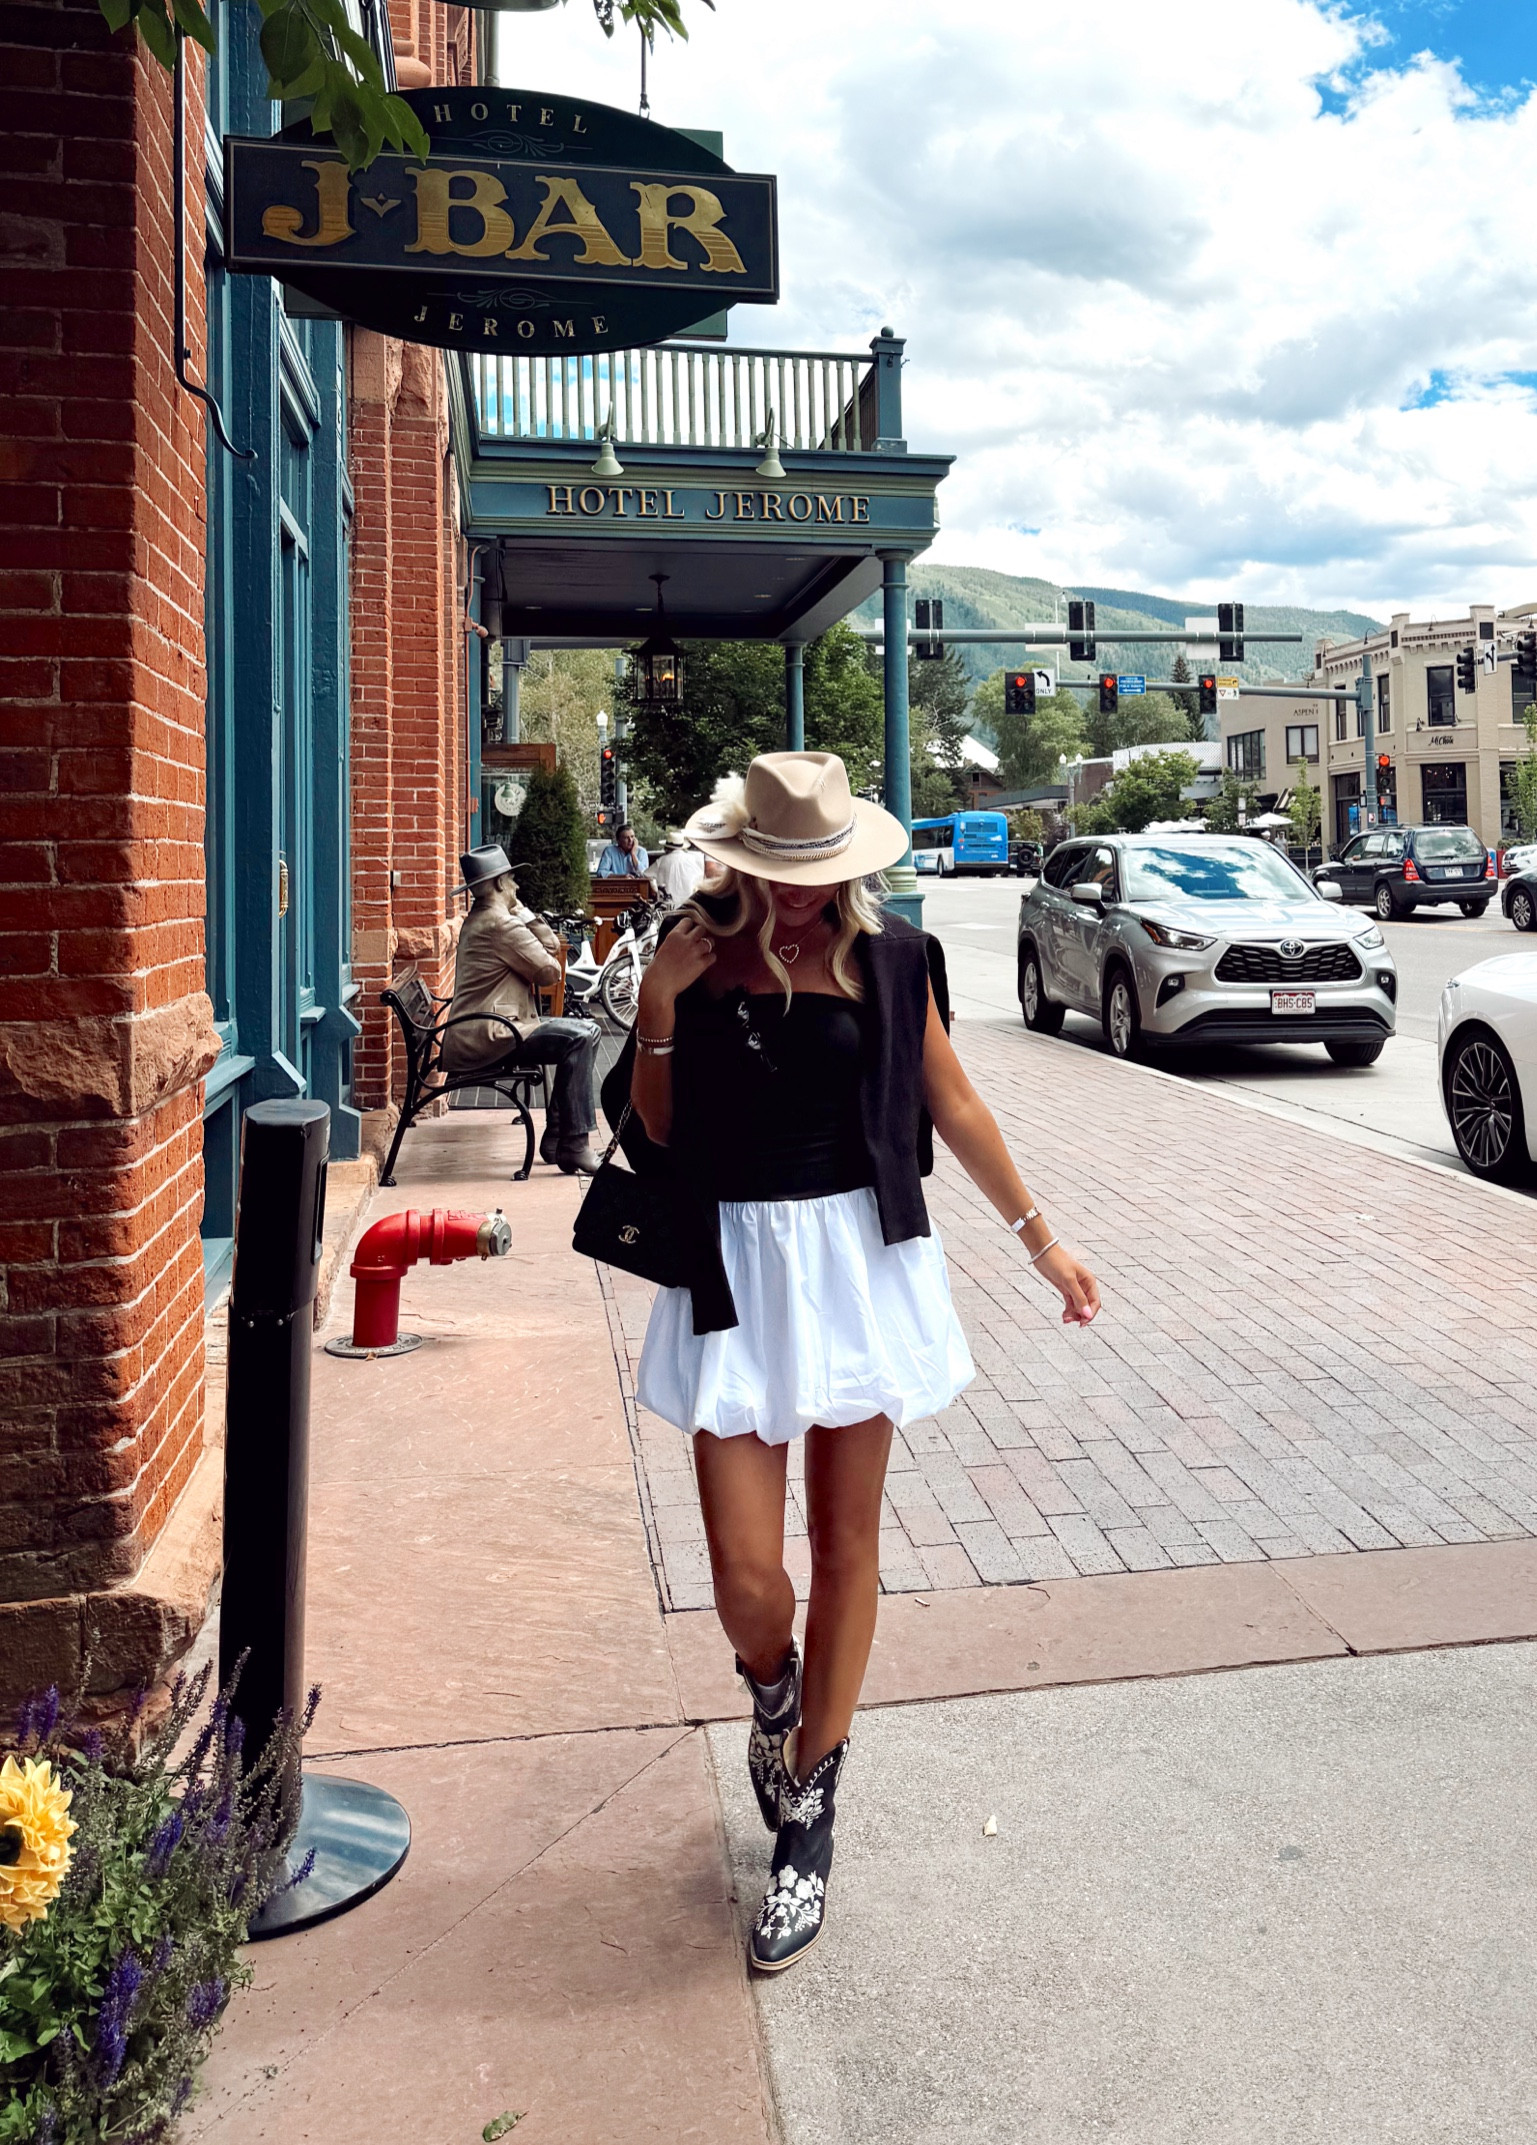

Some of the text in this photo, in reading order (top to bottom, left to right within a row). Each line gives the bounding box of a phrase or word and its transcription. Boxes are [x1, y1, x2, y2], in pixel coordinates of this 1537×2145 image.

[433, 103, 587, 134] HOTEL
[262, 160, 747, 274] J BAR
[414, 305, 609, 339] JEROME
[546, 485, 870, 524] HOTEL JEROME
